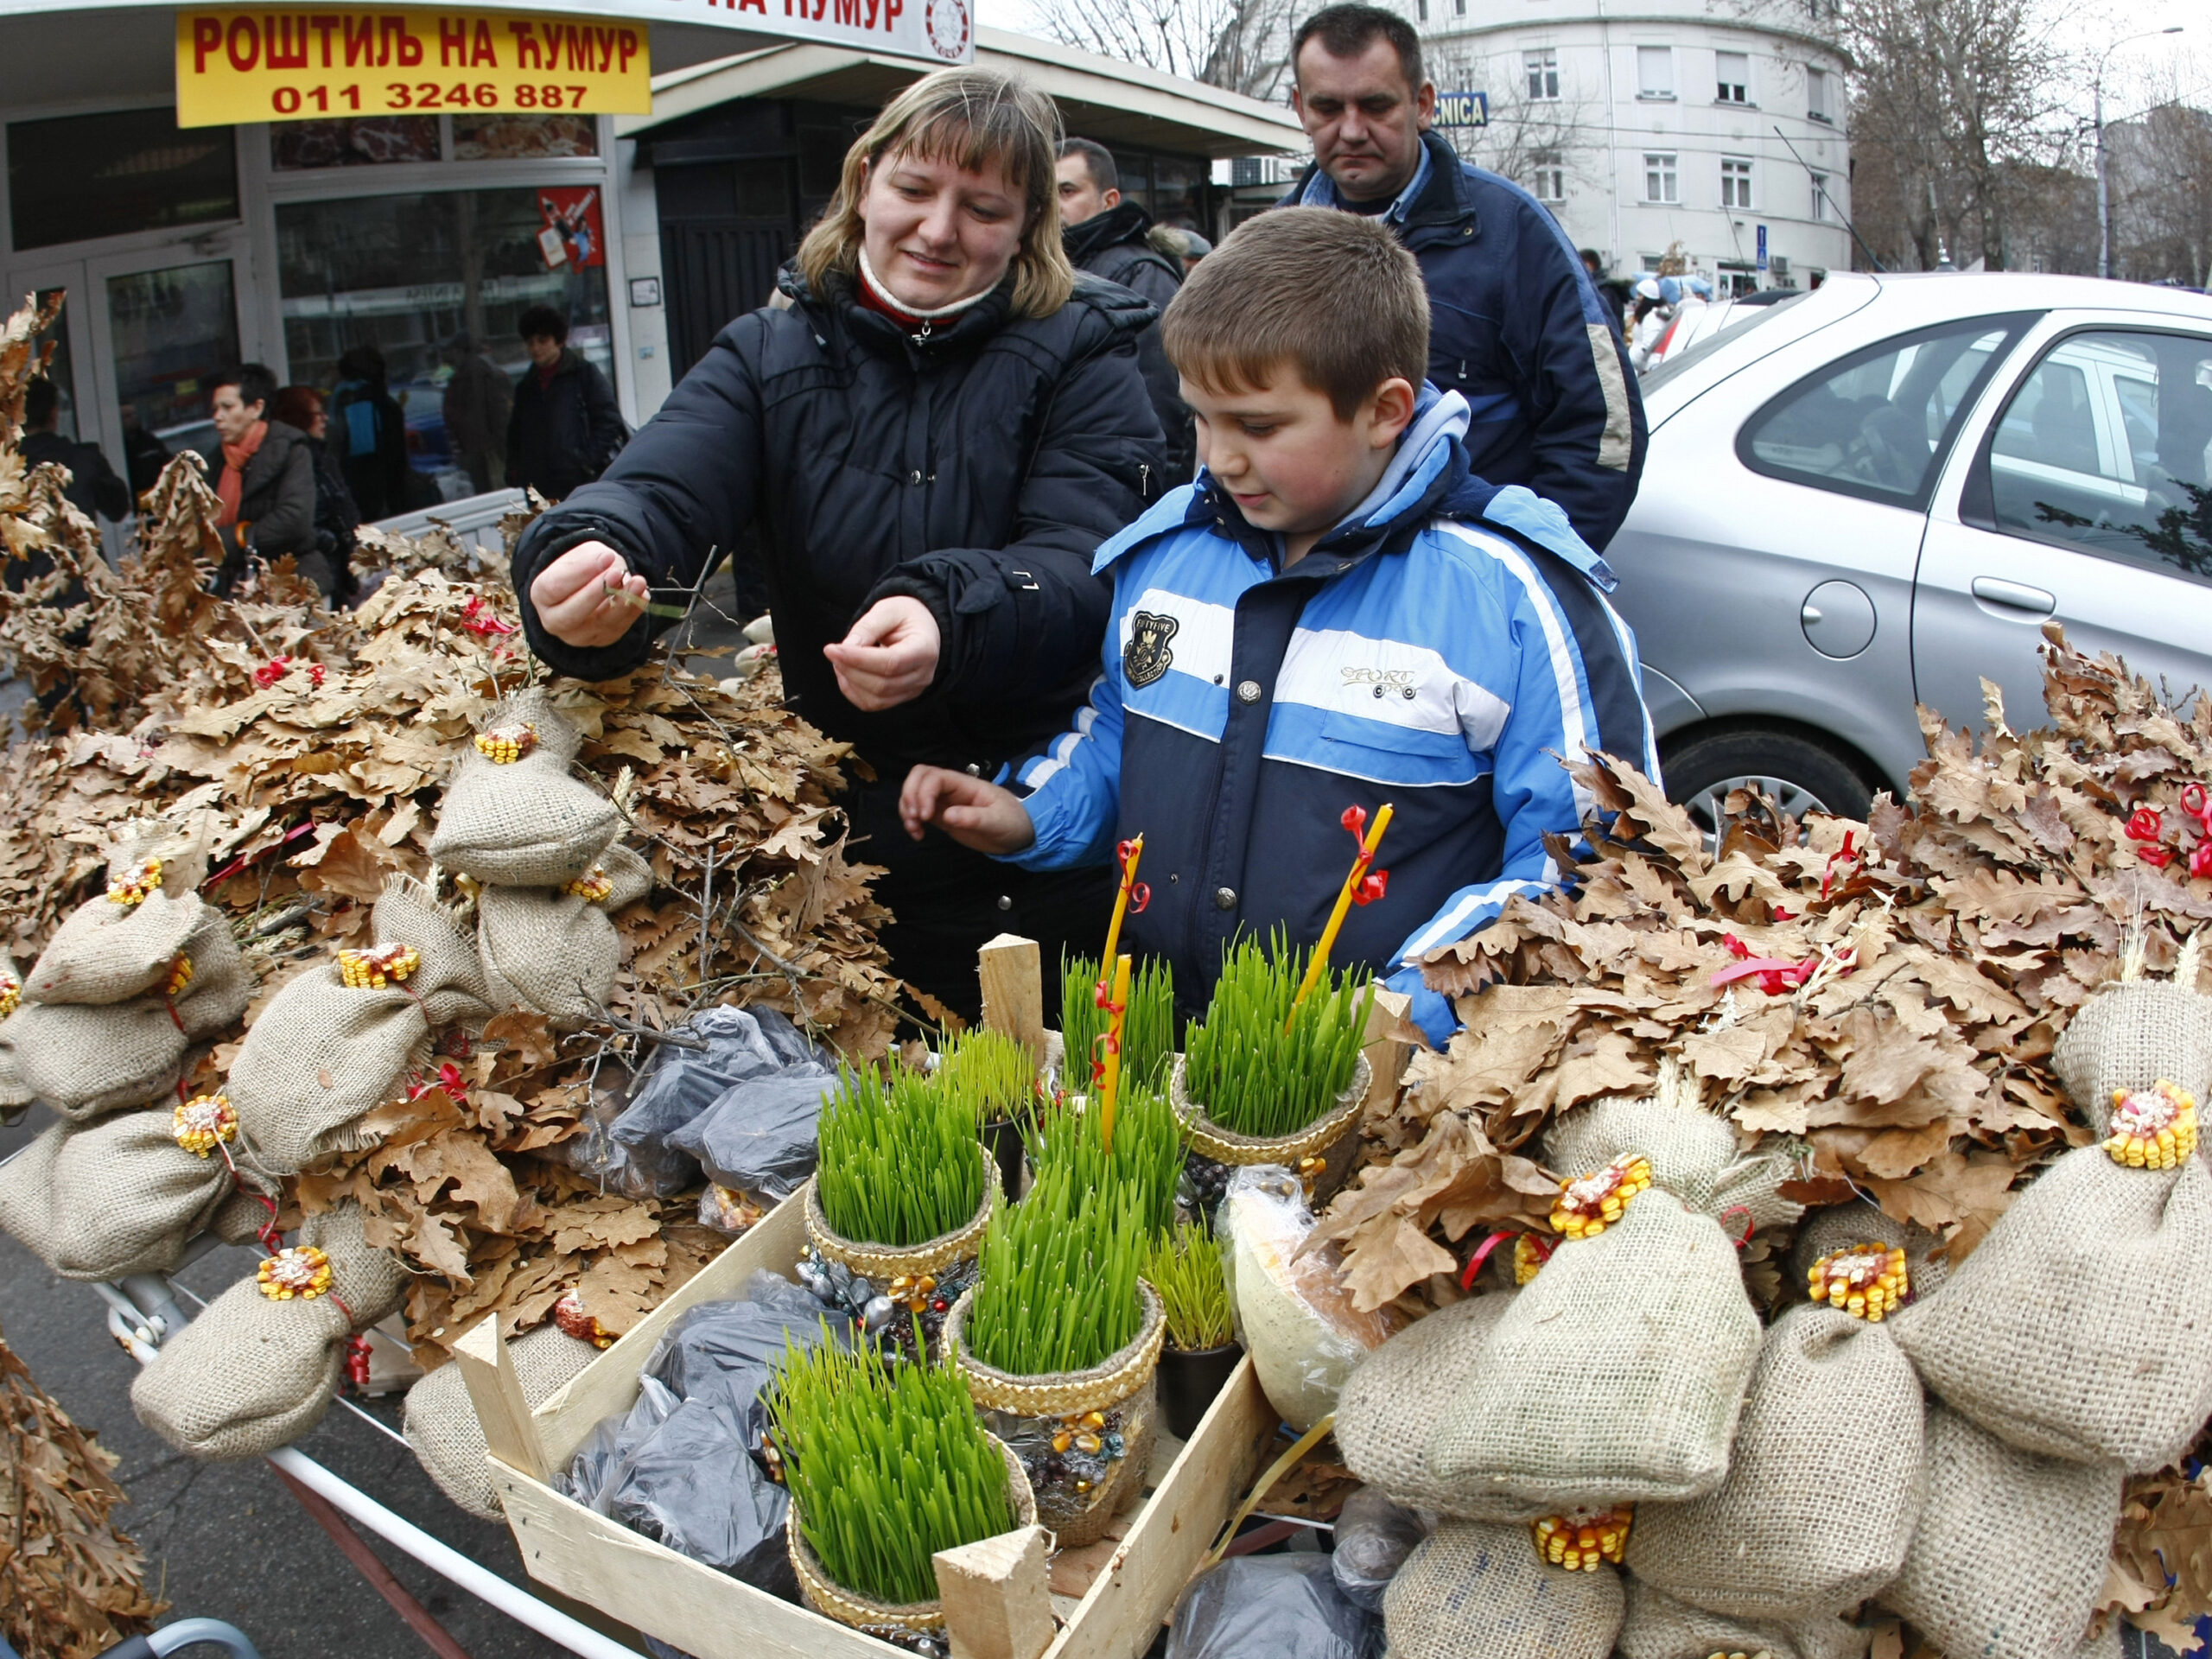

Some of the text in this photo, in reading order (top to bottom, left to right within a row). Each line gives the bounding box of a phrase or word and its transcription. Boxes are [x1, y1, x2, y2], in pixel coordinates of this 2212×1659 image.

[194, 16, 638, 73] РОШТИЉ НА ЋУМУР
[272, 82, 588, 113] 011 3246 887
[1341, 667, 1414, 683] SPORT
